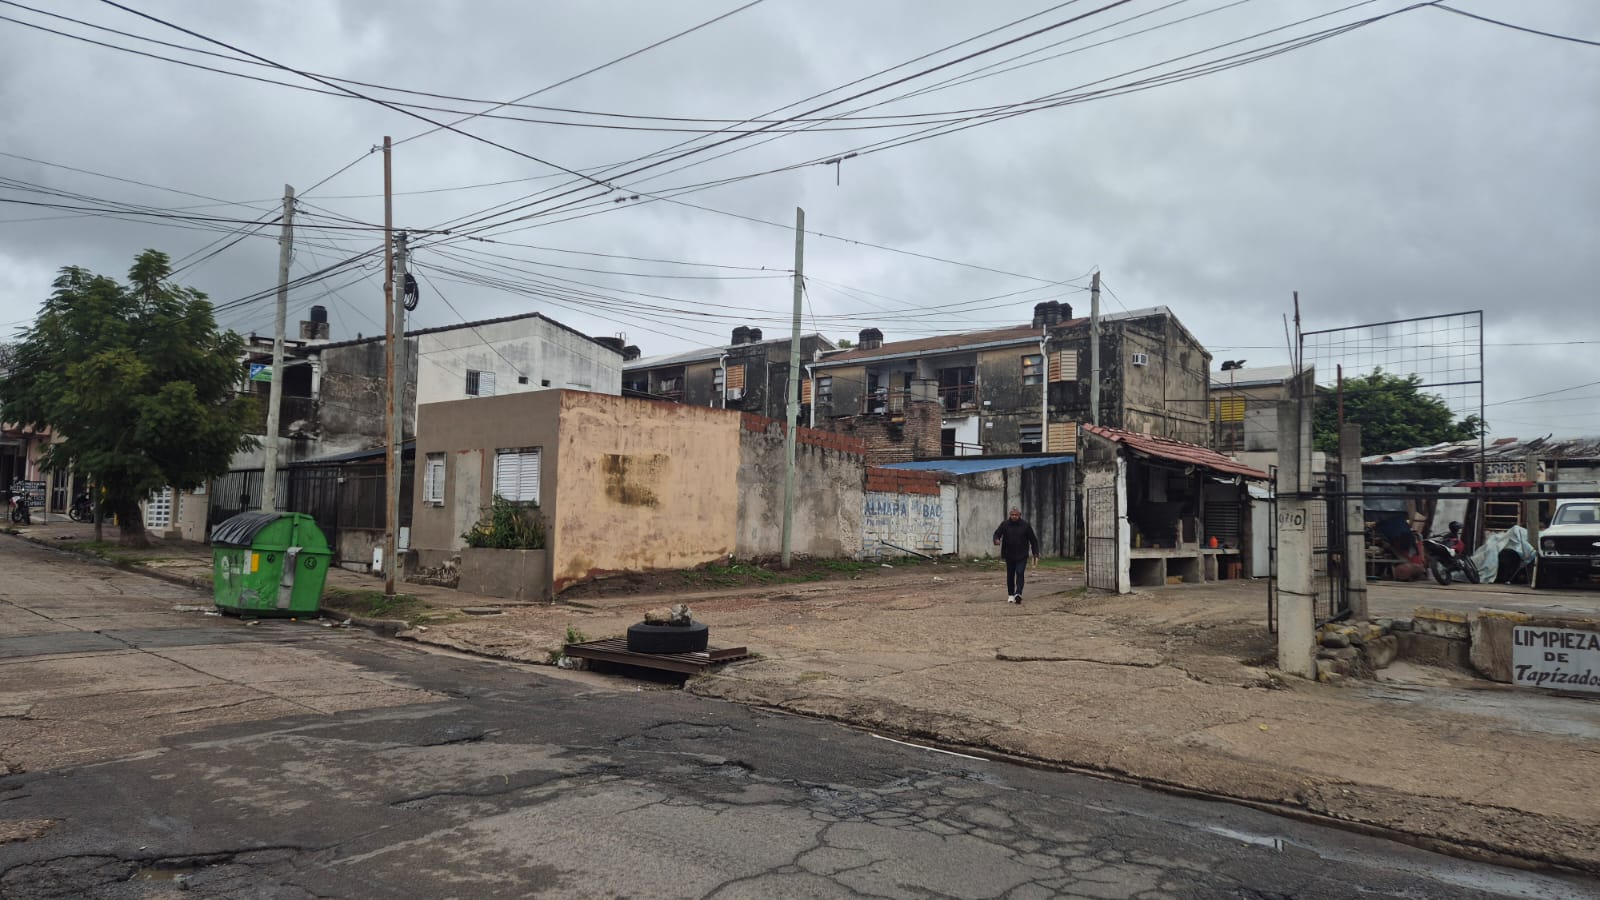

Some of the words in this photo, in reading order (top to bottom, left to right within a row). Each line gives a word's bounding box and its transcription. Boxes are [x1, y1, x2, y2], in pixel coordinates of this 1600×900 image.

[1475, 461, 1545, 474] ERRERA
[1514, 629, 1600, 651] LIMPIEZA
[1544, 652, 1569, 663] DE
